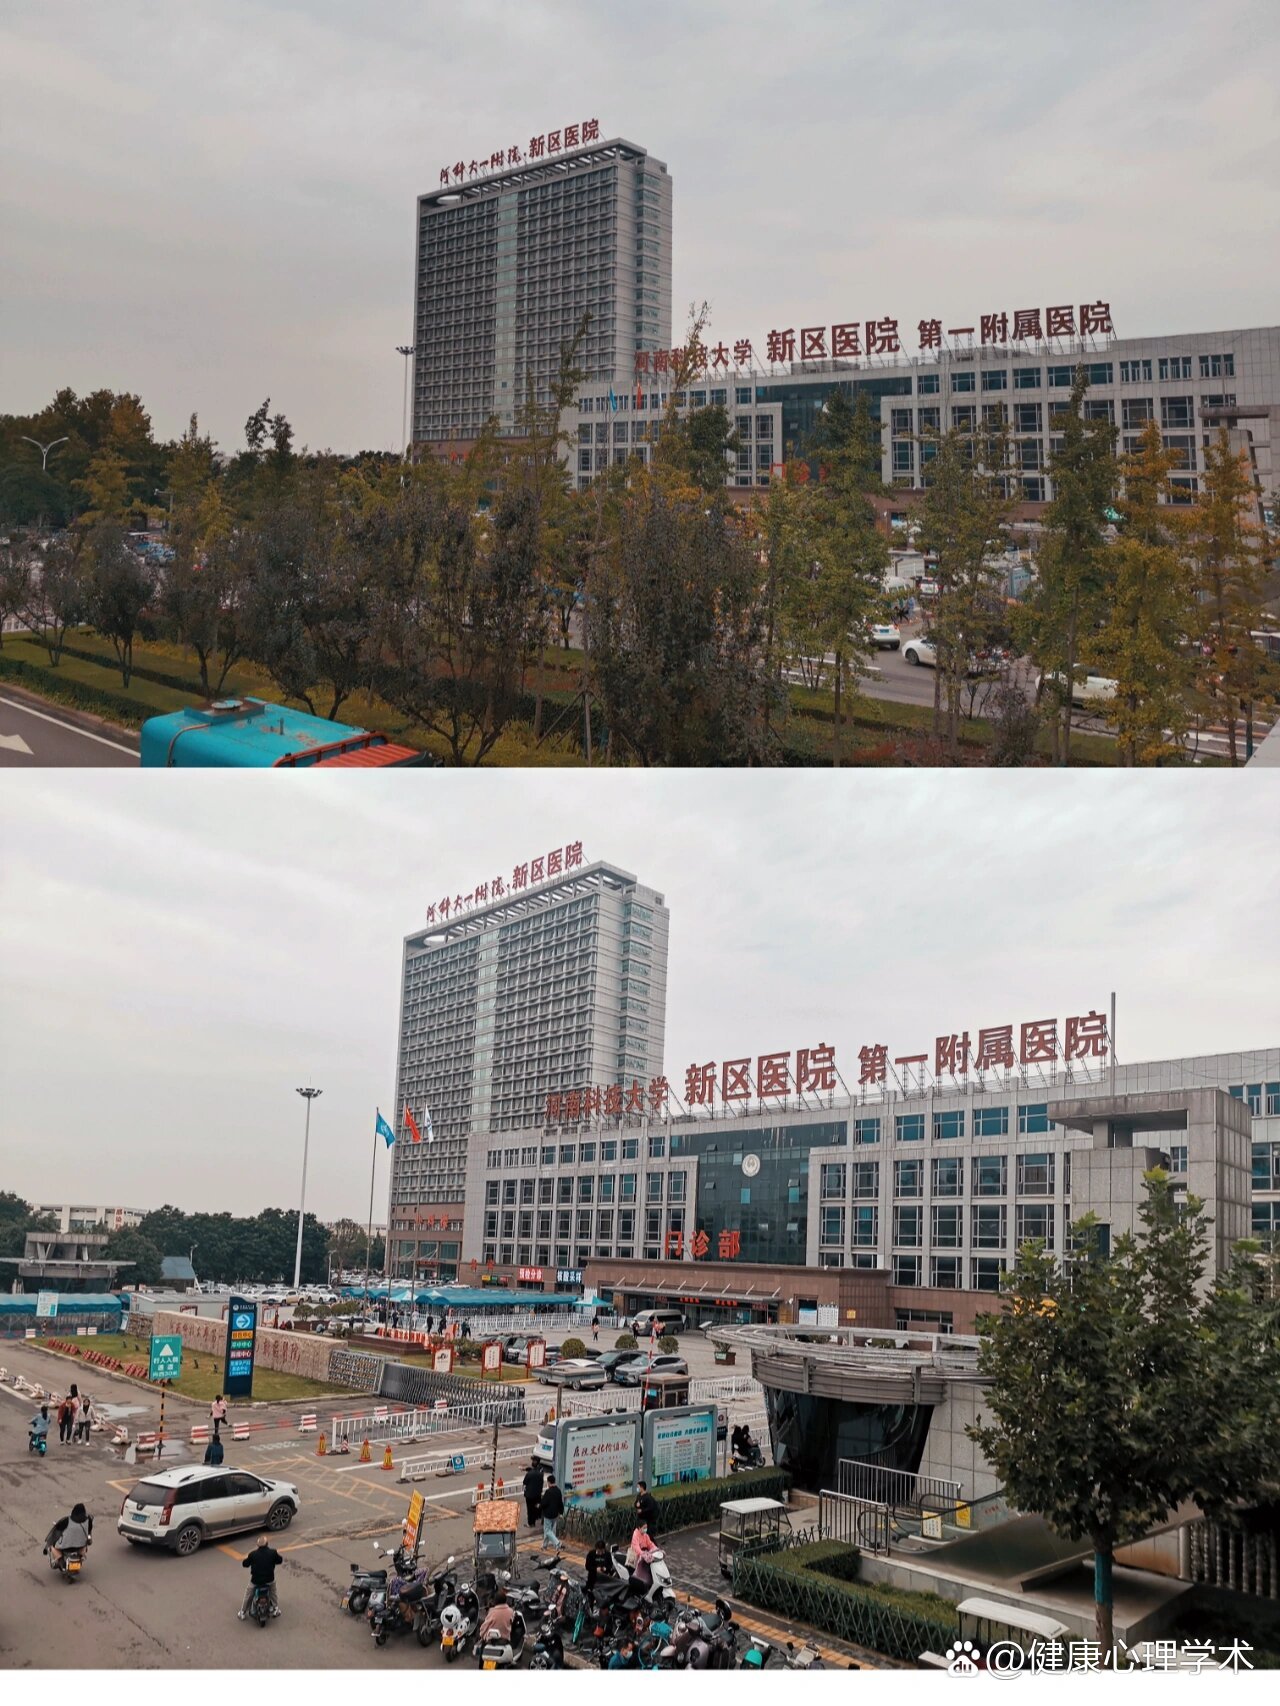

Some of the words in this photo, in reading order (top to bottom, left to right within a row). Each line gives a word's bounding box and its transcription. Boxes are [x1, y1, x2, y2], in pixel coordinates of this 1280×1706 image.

[766, 316, 900, 363] 新区医院
[917, 300, 1112, 350] 第一附属医院
[545, 1076, 669, 1119] 河南科技大学
[685, 1042, 837, 1106] 新区医院
[857, 1011, 1109, 1084] 第一附属医院
[665, 1229, 740, 1258] 门诊部
